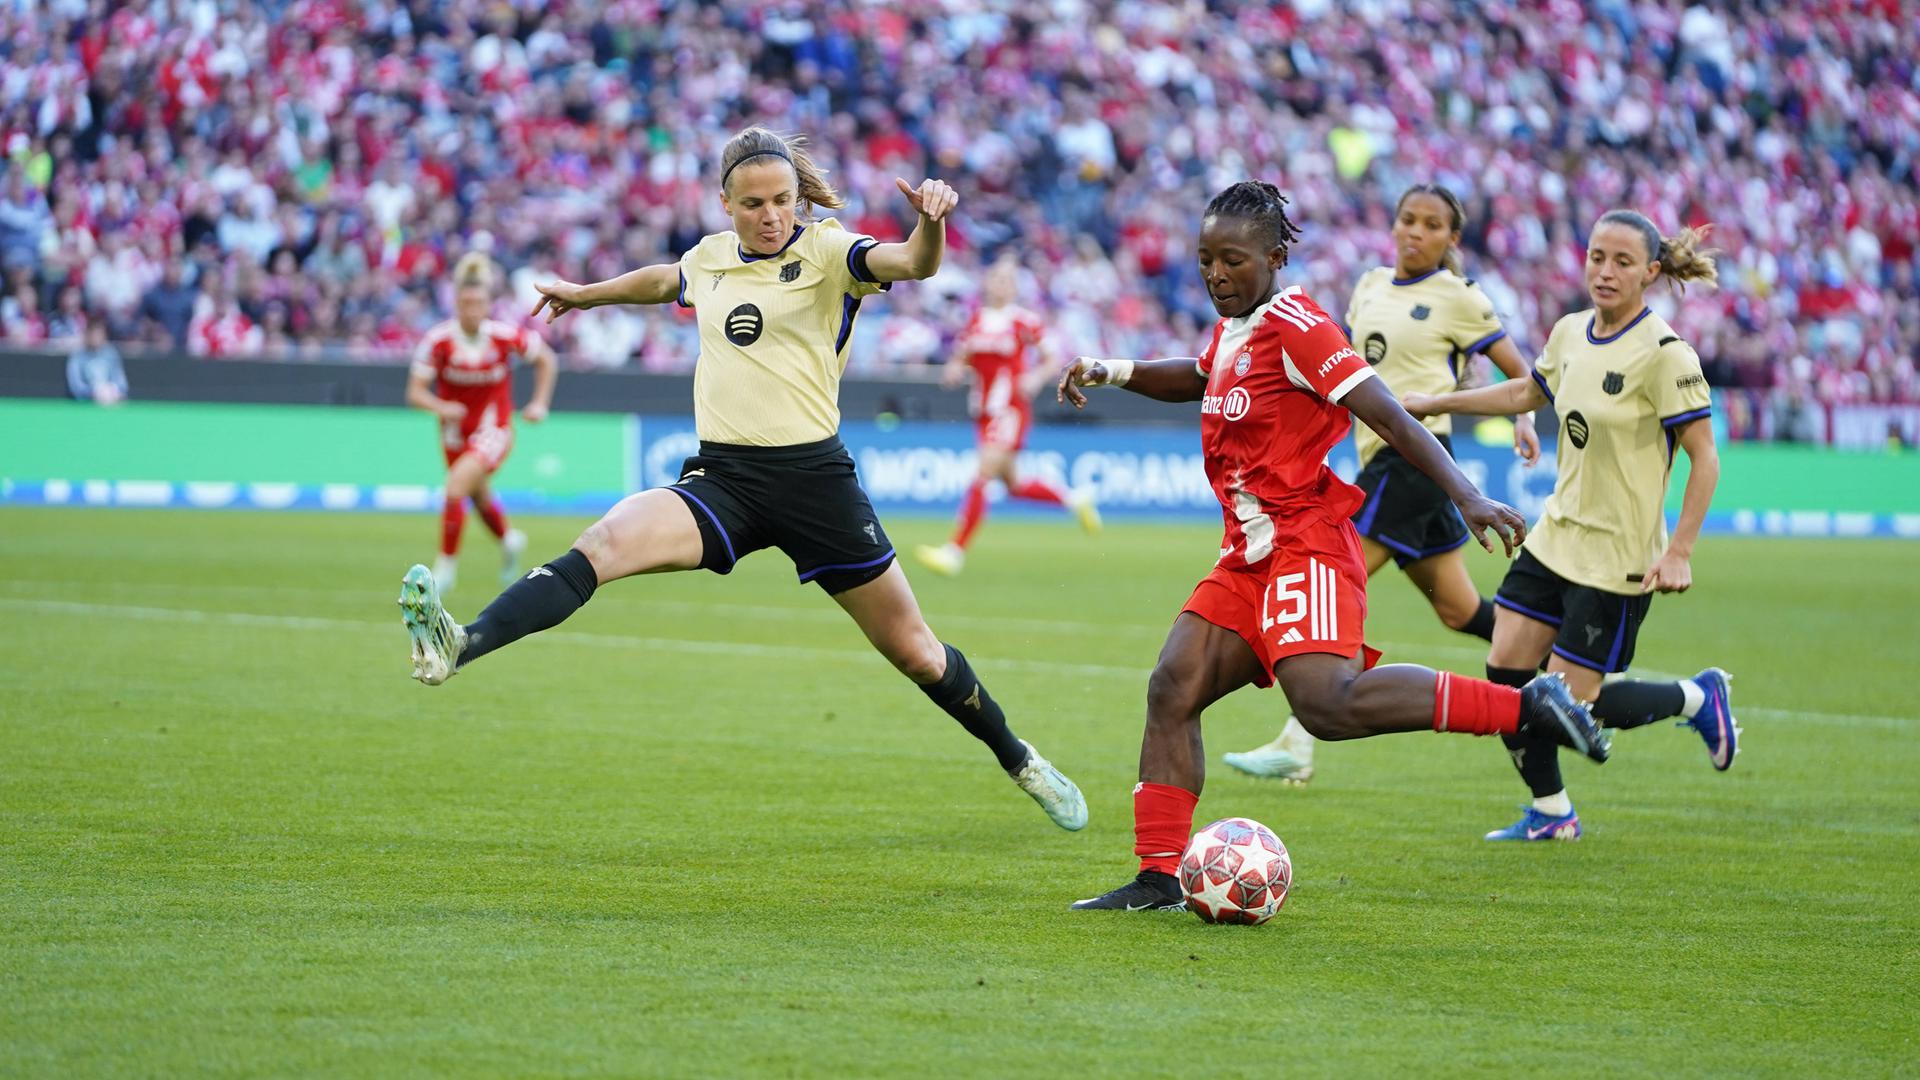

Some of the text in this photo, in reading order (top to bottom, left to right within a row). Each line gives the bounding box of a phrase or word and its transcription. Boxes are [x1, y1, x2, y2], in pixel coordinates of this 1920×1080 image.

[1200, 390, 1223, 415] anz
[860, 447, 1214, 507] WOMN'S CHAM
[1262, 572, 1307, 634] 15
